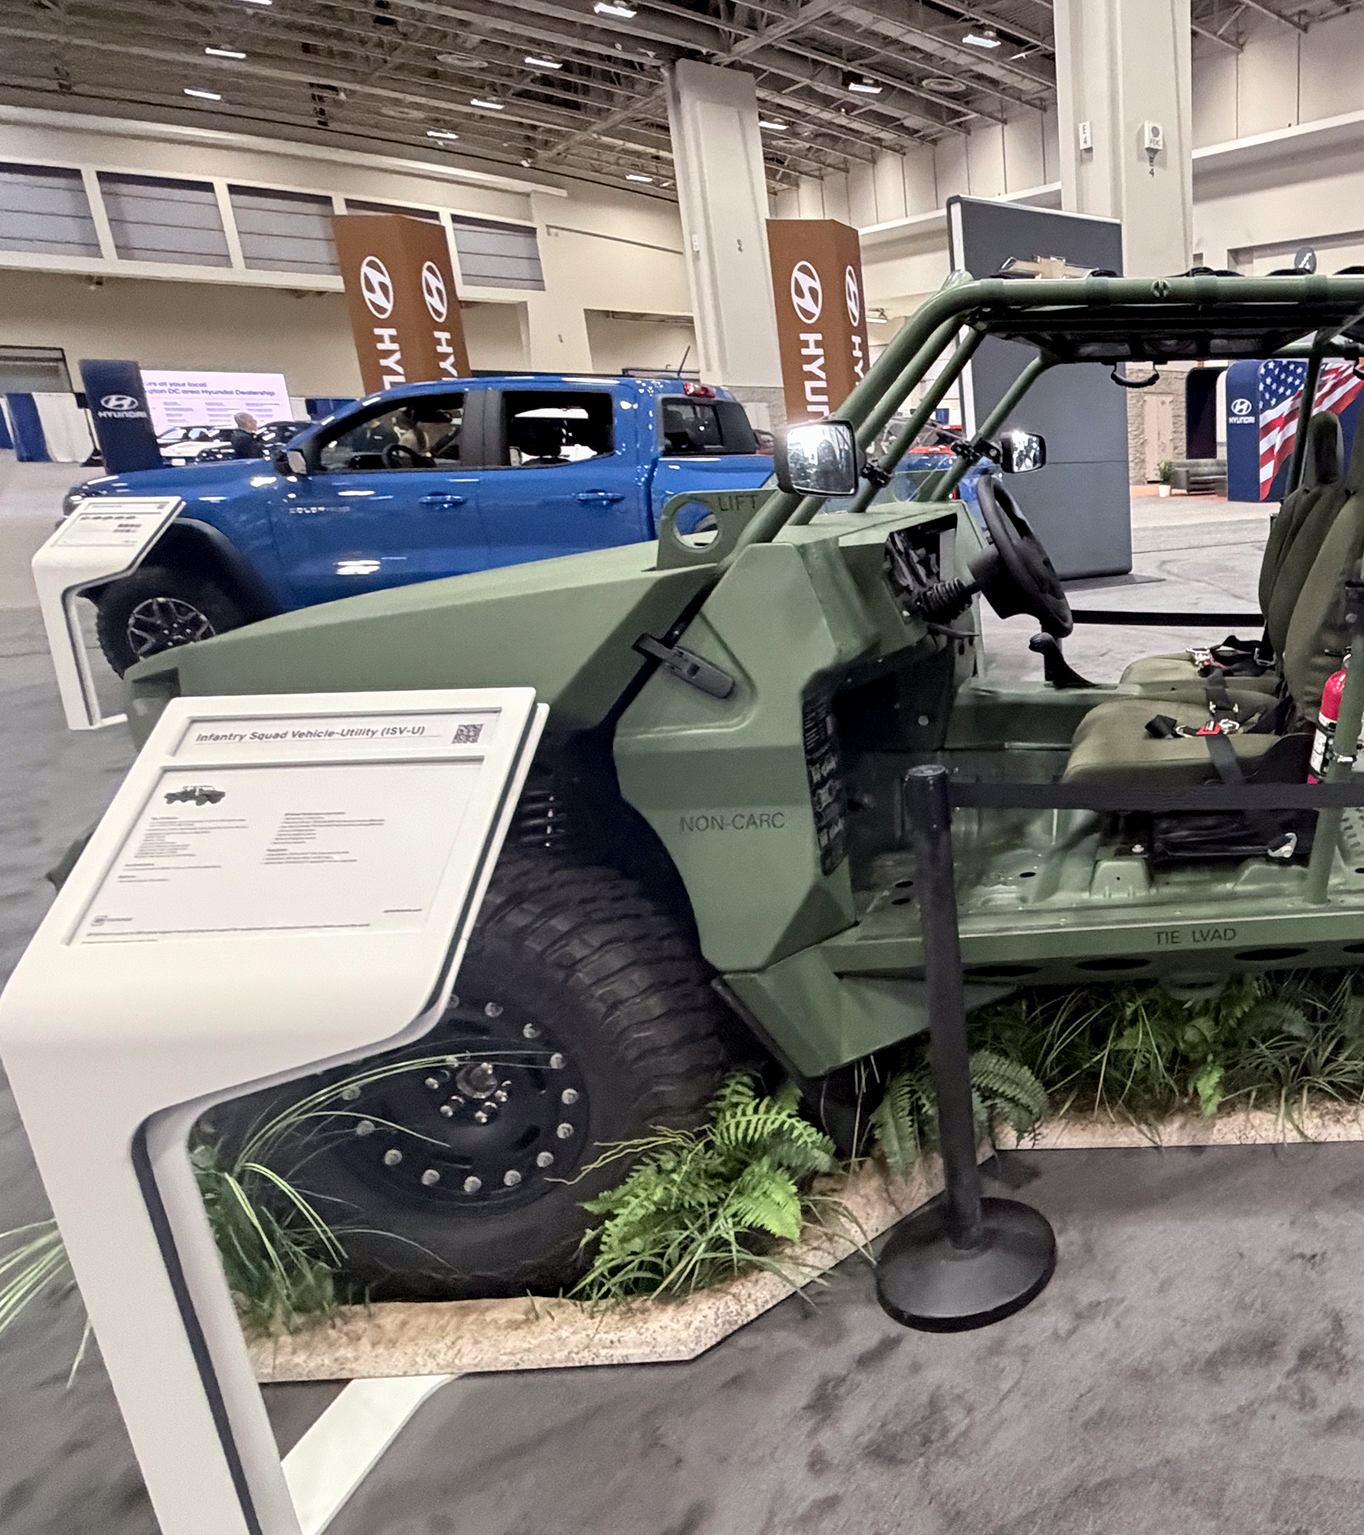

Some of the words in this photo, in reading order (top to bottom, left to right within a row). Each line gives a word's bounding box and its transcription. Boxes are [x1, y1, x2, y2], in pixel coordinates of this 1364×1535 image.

[1149, 168, 1155, 177] 4
[433, 331, 458, 381] HY
[851, 335, 866, 386] HY
[97, 410, 147, 418] HYUNDAI
[1229, 416, 1255, 424] HYUNDAI
[718, 494, 758, 512] LIFT
[196, 733, 247, 743] Infantry
[249, 731, 287, 741] Squad
[291, 727, 379, 739] Vehicle-Utility
[380, 725, 425, 737] (ISV-U)
[680, 812, 785, 832] NON-CARC
[1154, 930, 1182, 945] TIE
[1191, 928, 1237, 943] LVAD
